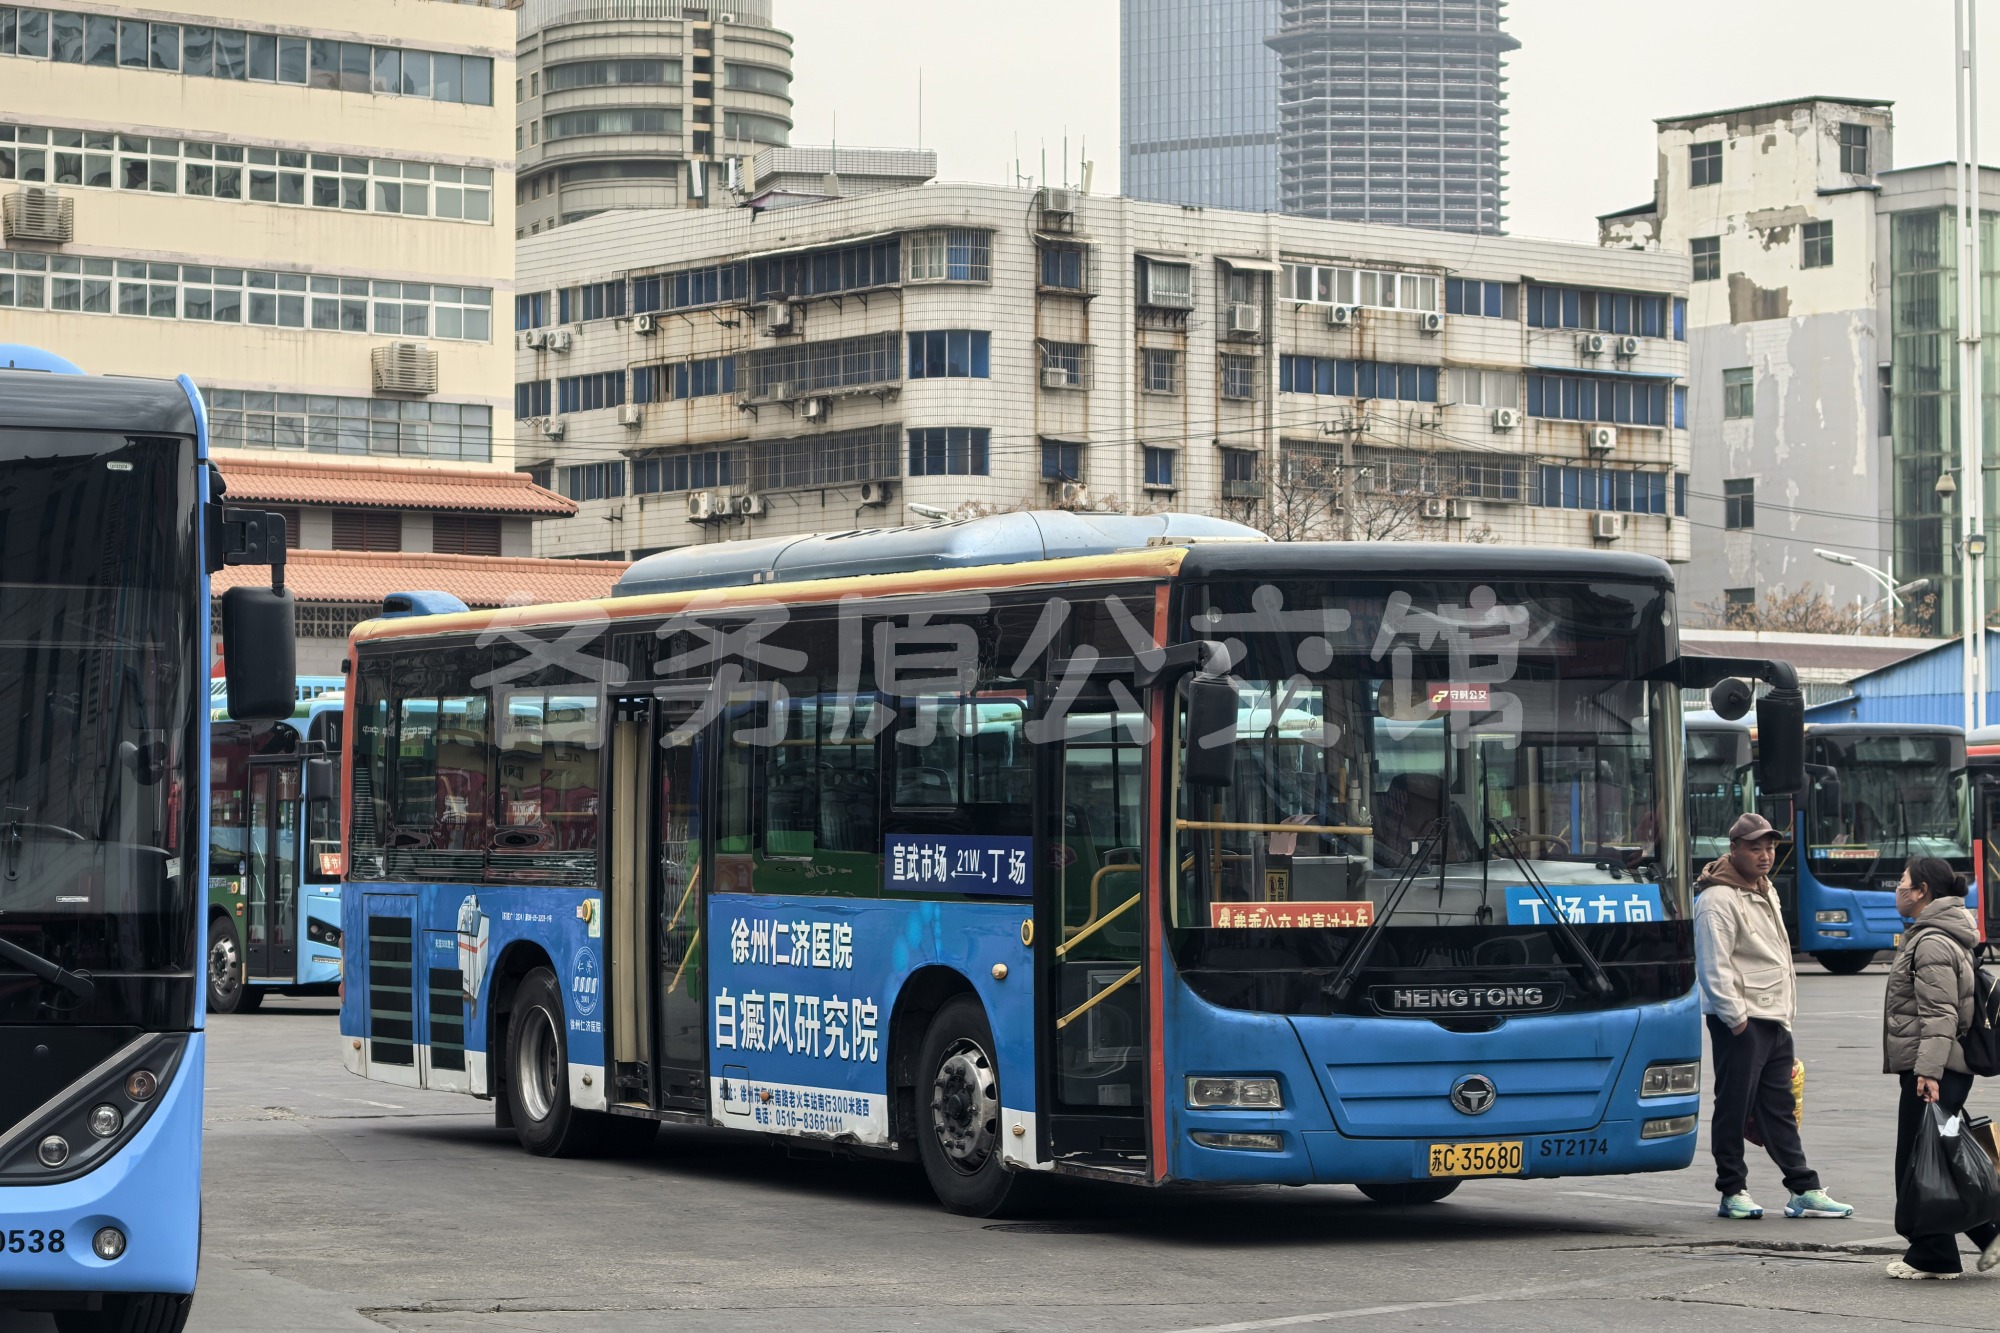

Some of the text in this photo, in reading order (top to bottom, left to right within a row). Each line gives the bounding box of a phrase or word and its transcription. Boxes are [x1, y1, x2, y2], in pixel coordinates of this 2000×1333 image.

[893, 843, 1026, 885] 宣武市场 21W 丁场
[1518, 893, 1653, 924] 丁场方向
[730, 917, 853, 970] 徐州仁济医院
[1394, 987, 1544, 1009] HENGTONG
[570, 1018, 602, 1033] 徐州仁济医院
[715, 986, 879, 1062] 白癜风研究院
[1540, 1138, 1609, 1157] ST2174
